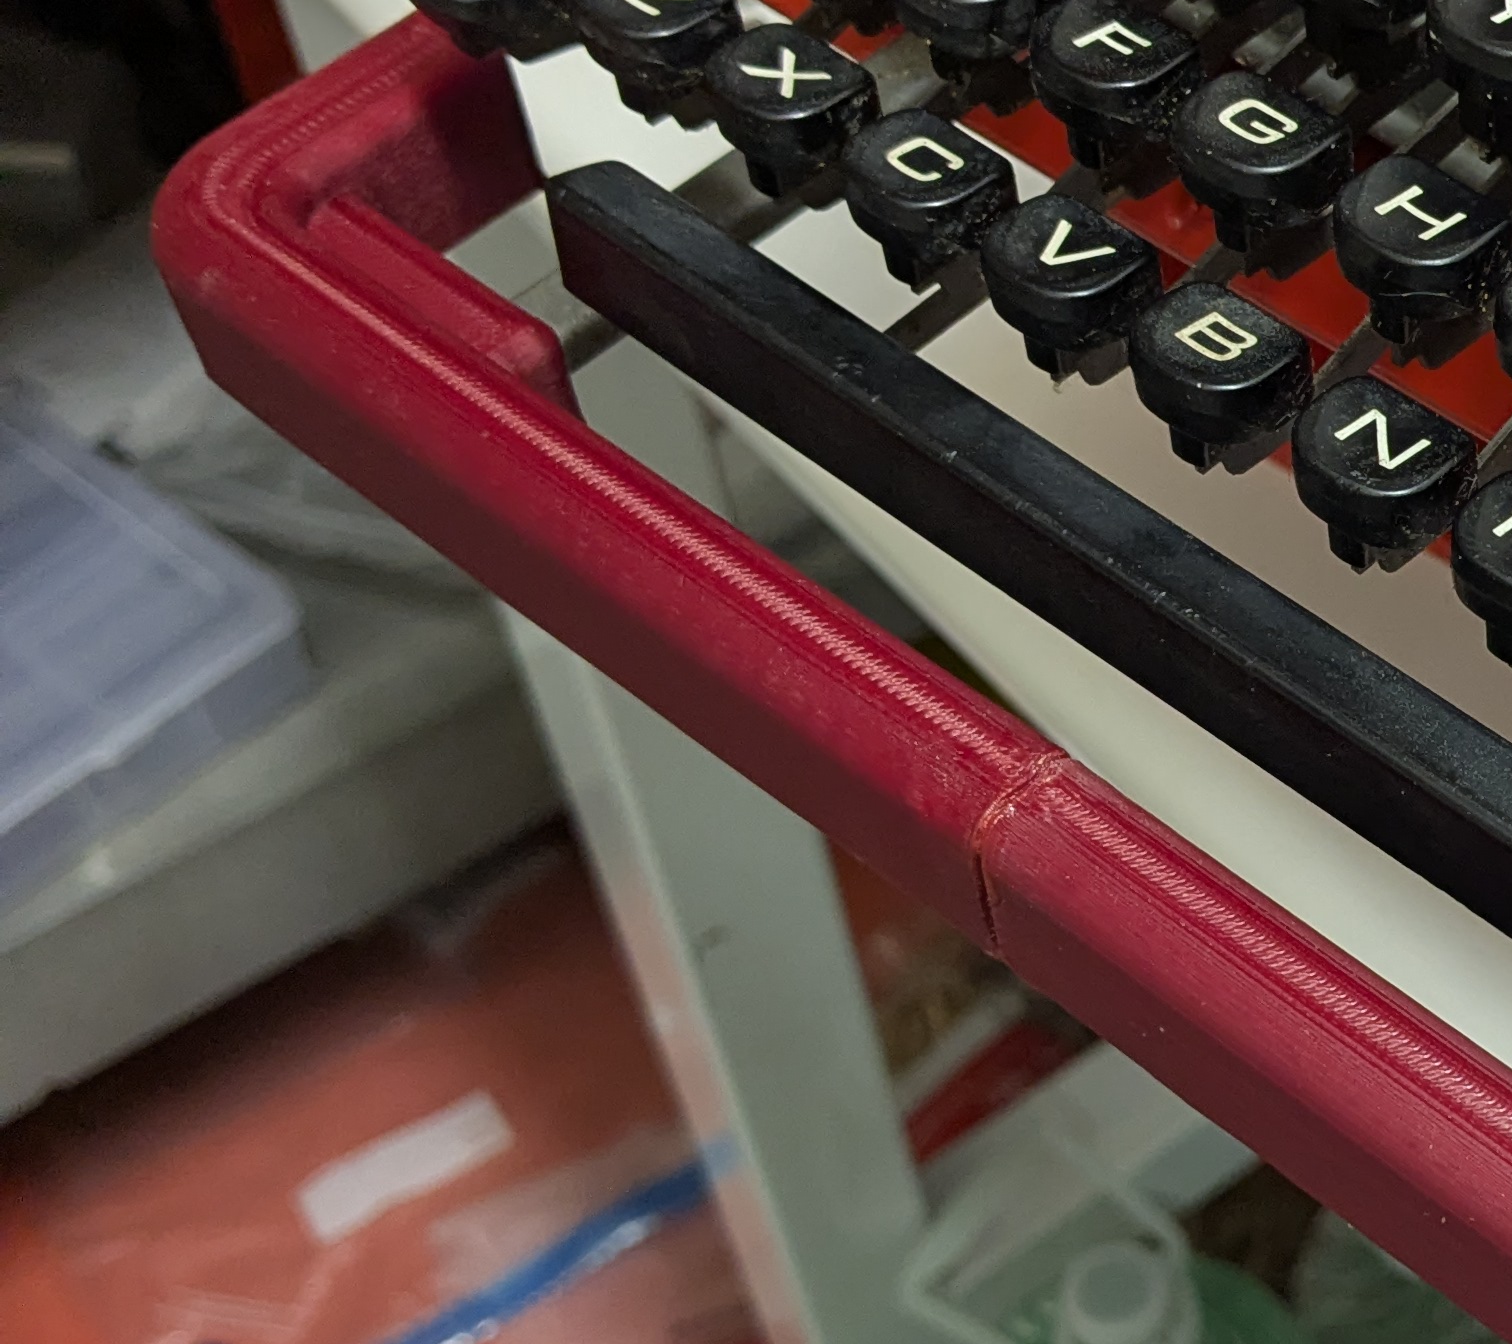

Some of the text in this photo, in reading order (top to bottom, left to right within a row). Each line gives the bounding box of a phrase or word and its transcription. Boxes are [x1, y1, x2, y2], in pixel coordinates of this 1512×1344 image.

[1070, 19, 1153, 57] F
[738, 46, 833, 100] X
[1216, 97, 1300, 146] G
[884, 135, 966, 183] C
[1372, 183, 1468, 242] H
[1038, 217, 1118, 267] V
[1173, 310, 1259, 363] B
[1332, 407, 1433, 471] N
